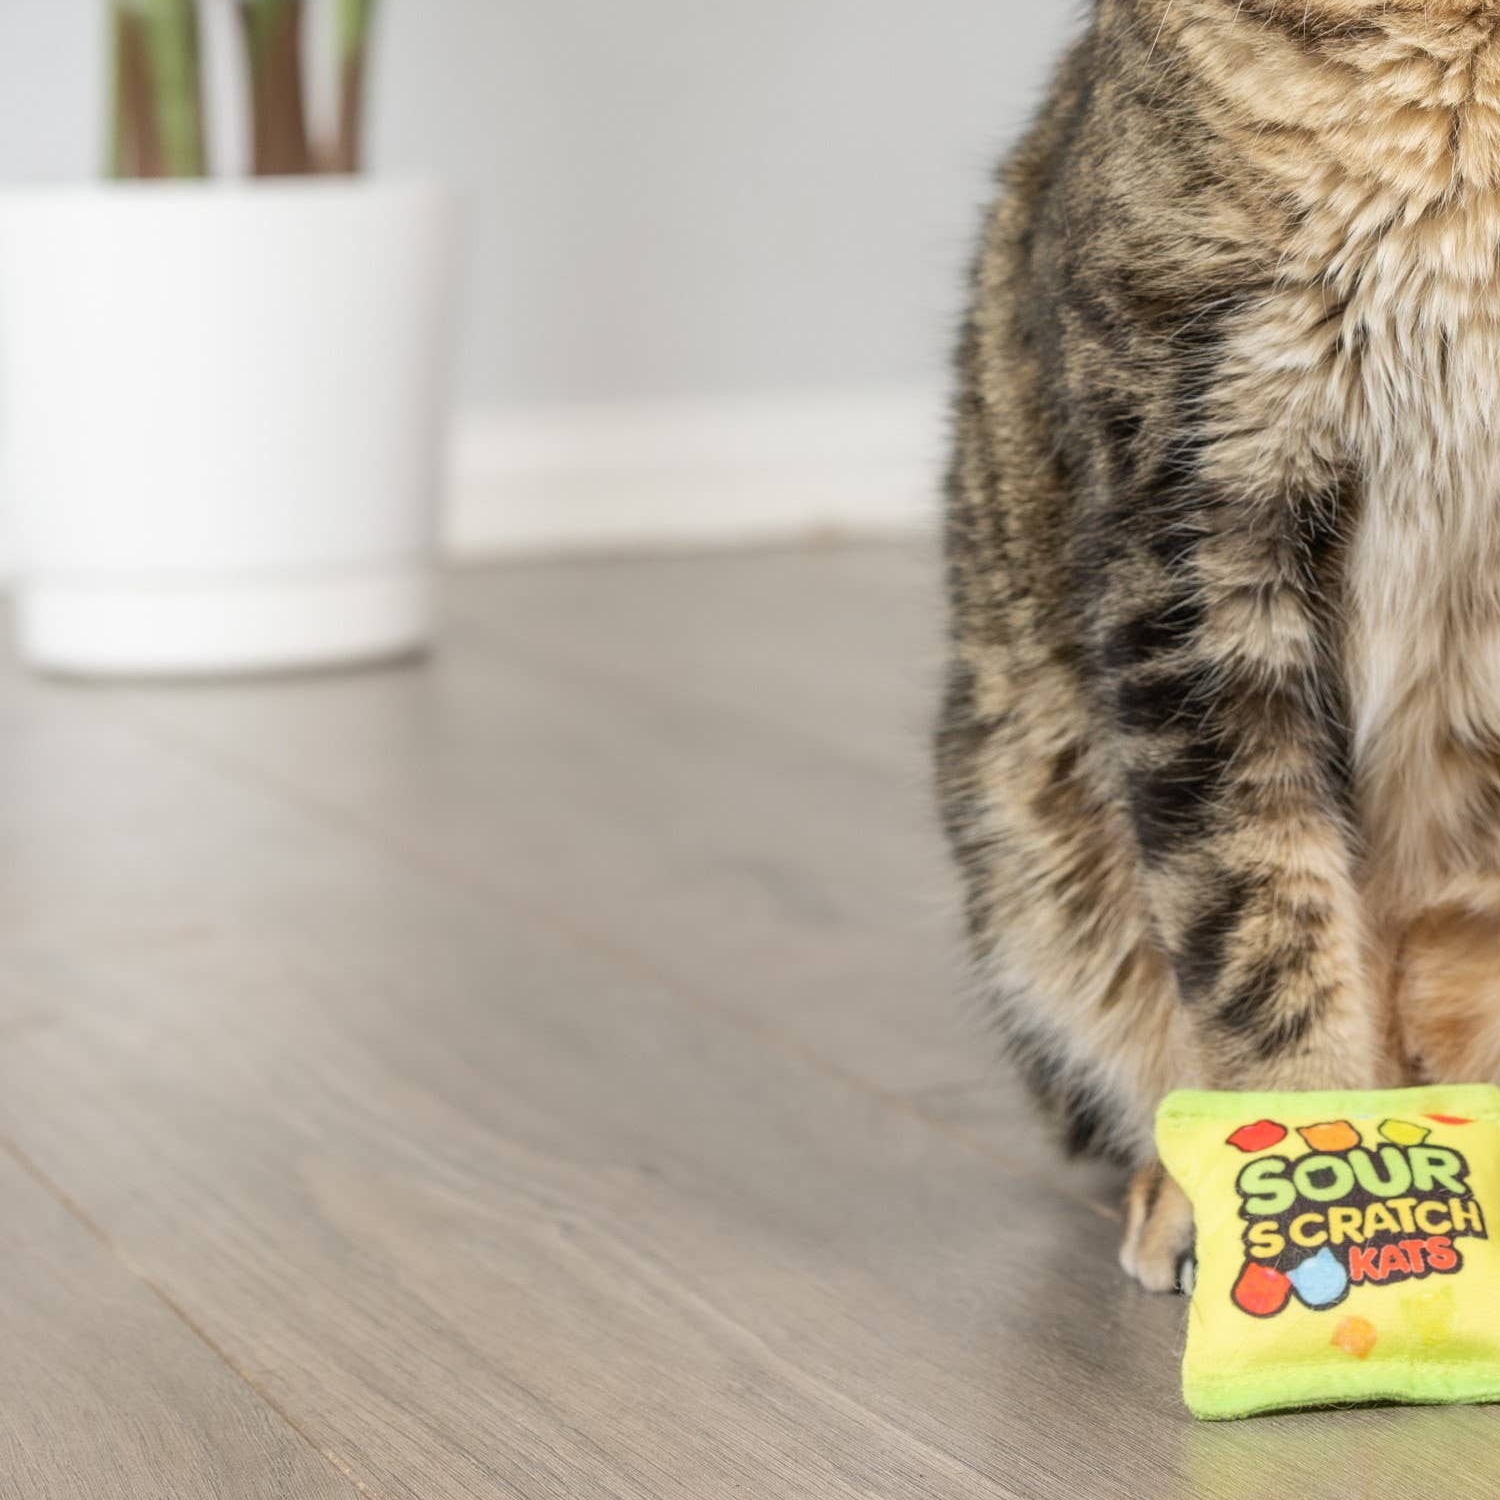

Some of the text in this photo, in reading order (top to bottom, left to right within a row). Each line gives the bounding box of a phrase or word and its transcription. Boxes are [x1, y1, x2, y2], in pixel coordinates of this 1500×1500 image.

[1239, 1146, 1467, 1215] SOUR
[1248, 1197, 1482, 1258] SCRATCH
[1349, 1236, 1457, 1281] KATS
